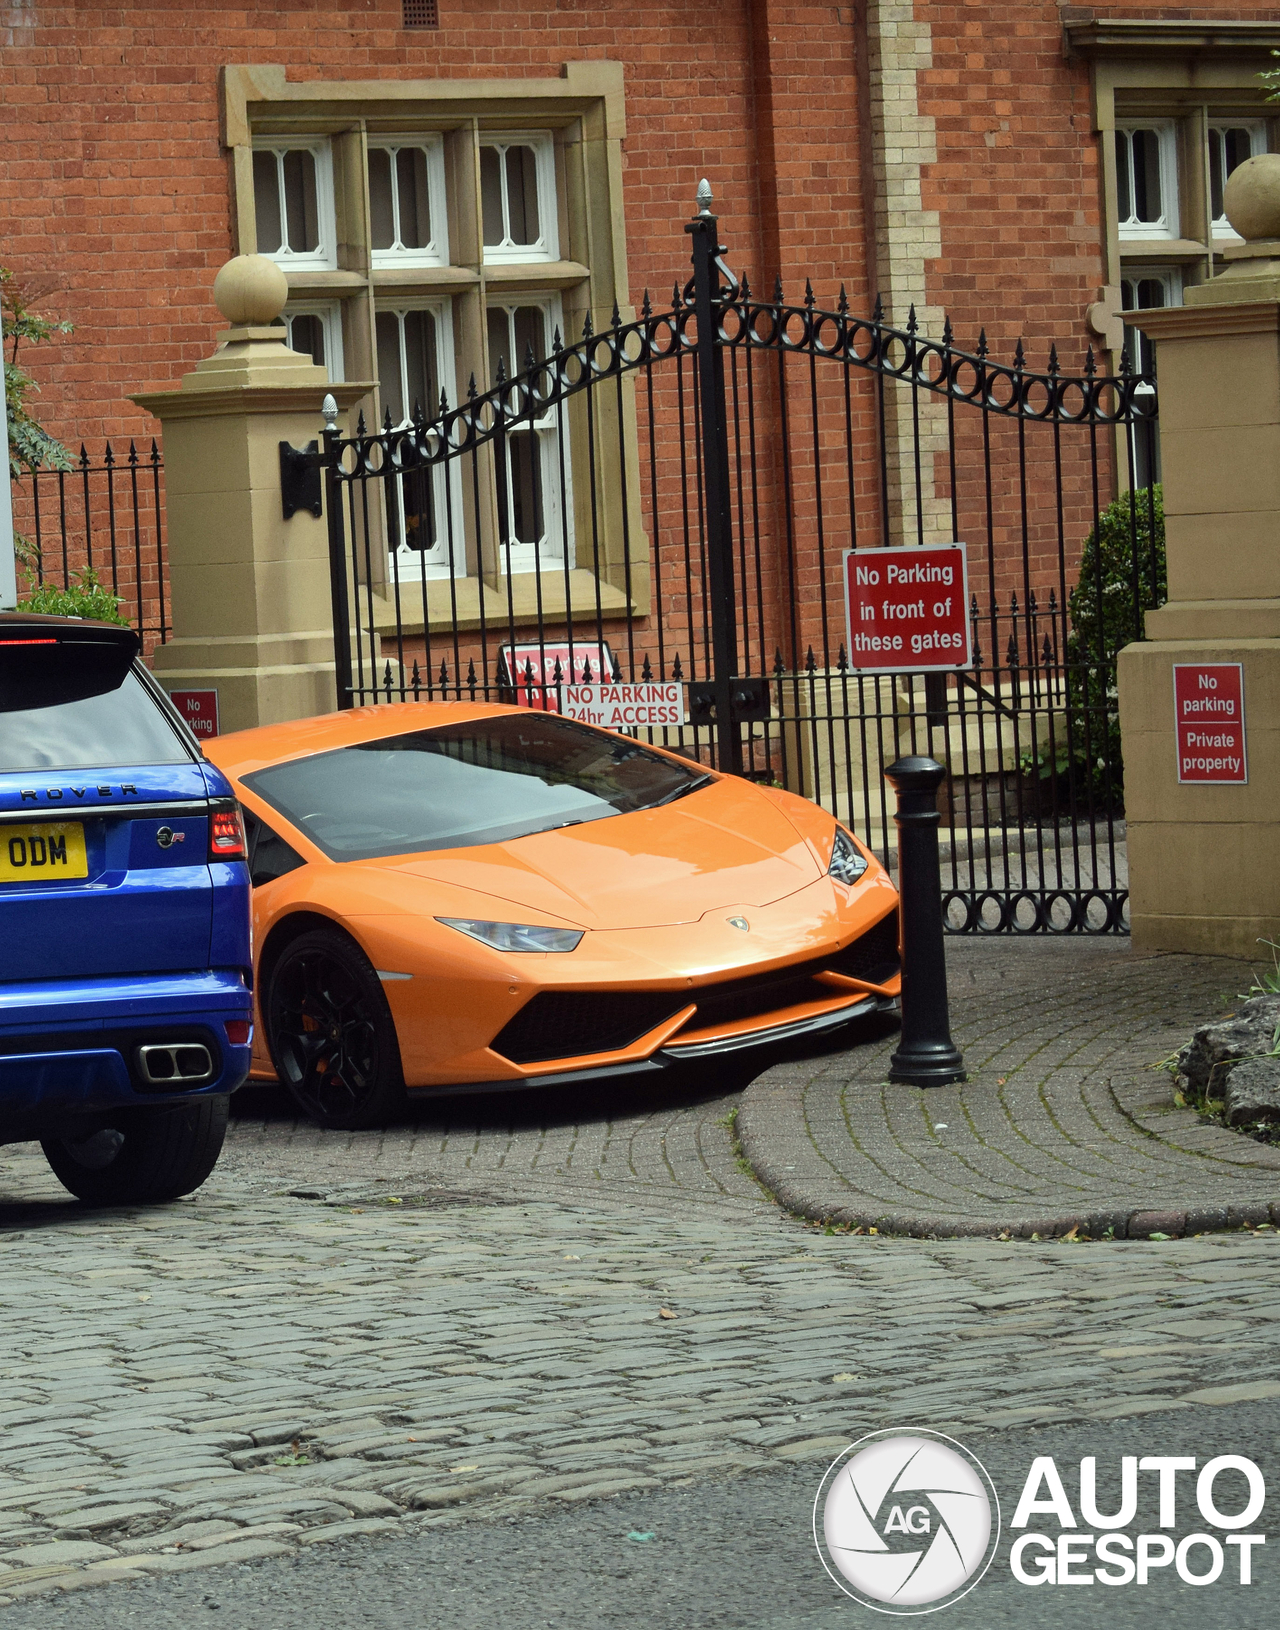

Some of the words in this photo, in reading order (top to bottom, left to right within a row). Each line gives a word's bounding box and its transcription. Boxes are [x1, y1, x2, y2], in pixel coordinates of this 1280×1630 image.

[856, 565, 880, 586] No
[887, 562, 954, 586] Parking
[860, 601, 875, 620] in
[882, 599, 925, 620] front
[933, 597, 952, 617] of
[854, 632, 903, 651] these
[911, 630, 963, 654] gates
[1198, 674, 1218, 690] No
[567, 686, 594, 704] NO
[600, 685, 678, 704] PARKING
[187, 699, 200, 711] No
[1183, 697, 1235, 715] parking
[568, 707, 605, 724] 24hr
[611, 706, 679, 724] ACCESS
[188, 717, 213, 733] rking
[1186, 732, 1235, 747] Private
[1183, 755, 1241, 773] property
[20, 784, 138, 802] ROVER
[8, 835, 68, 867] ODM
